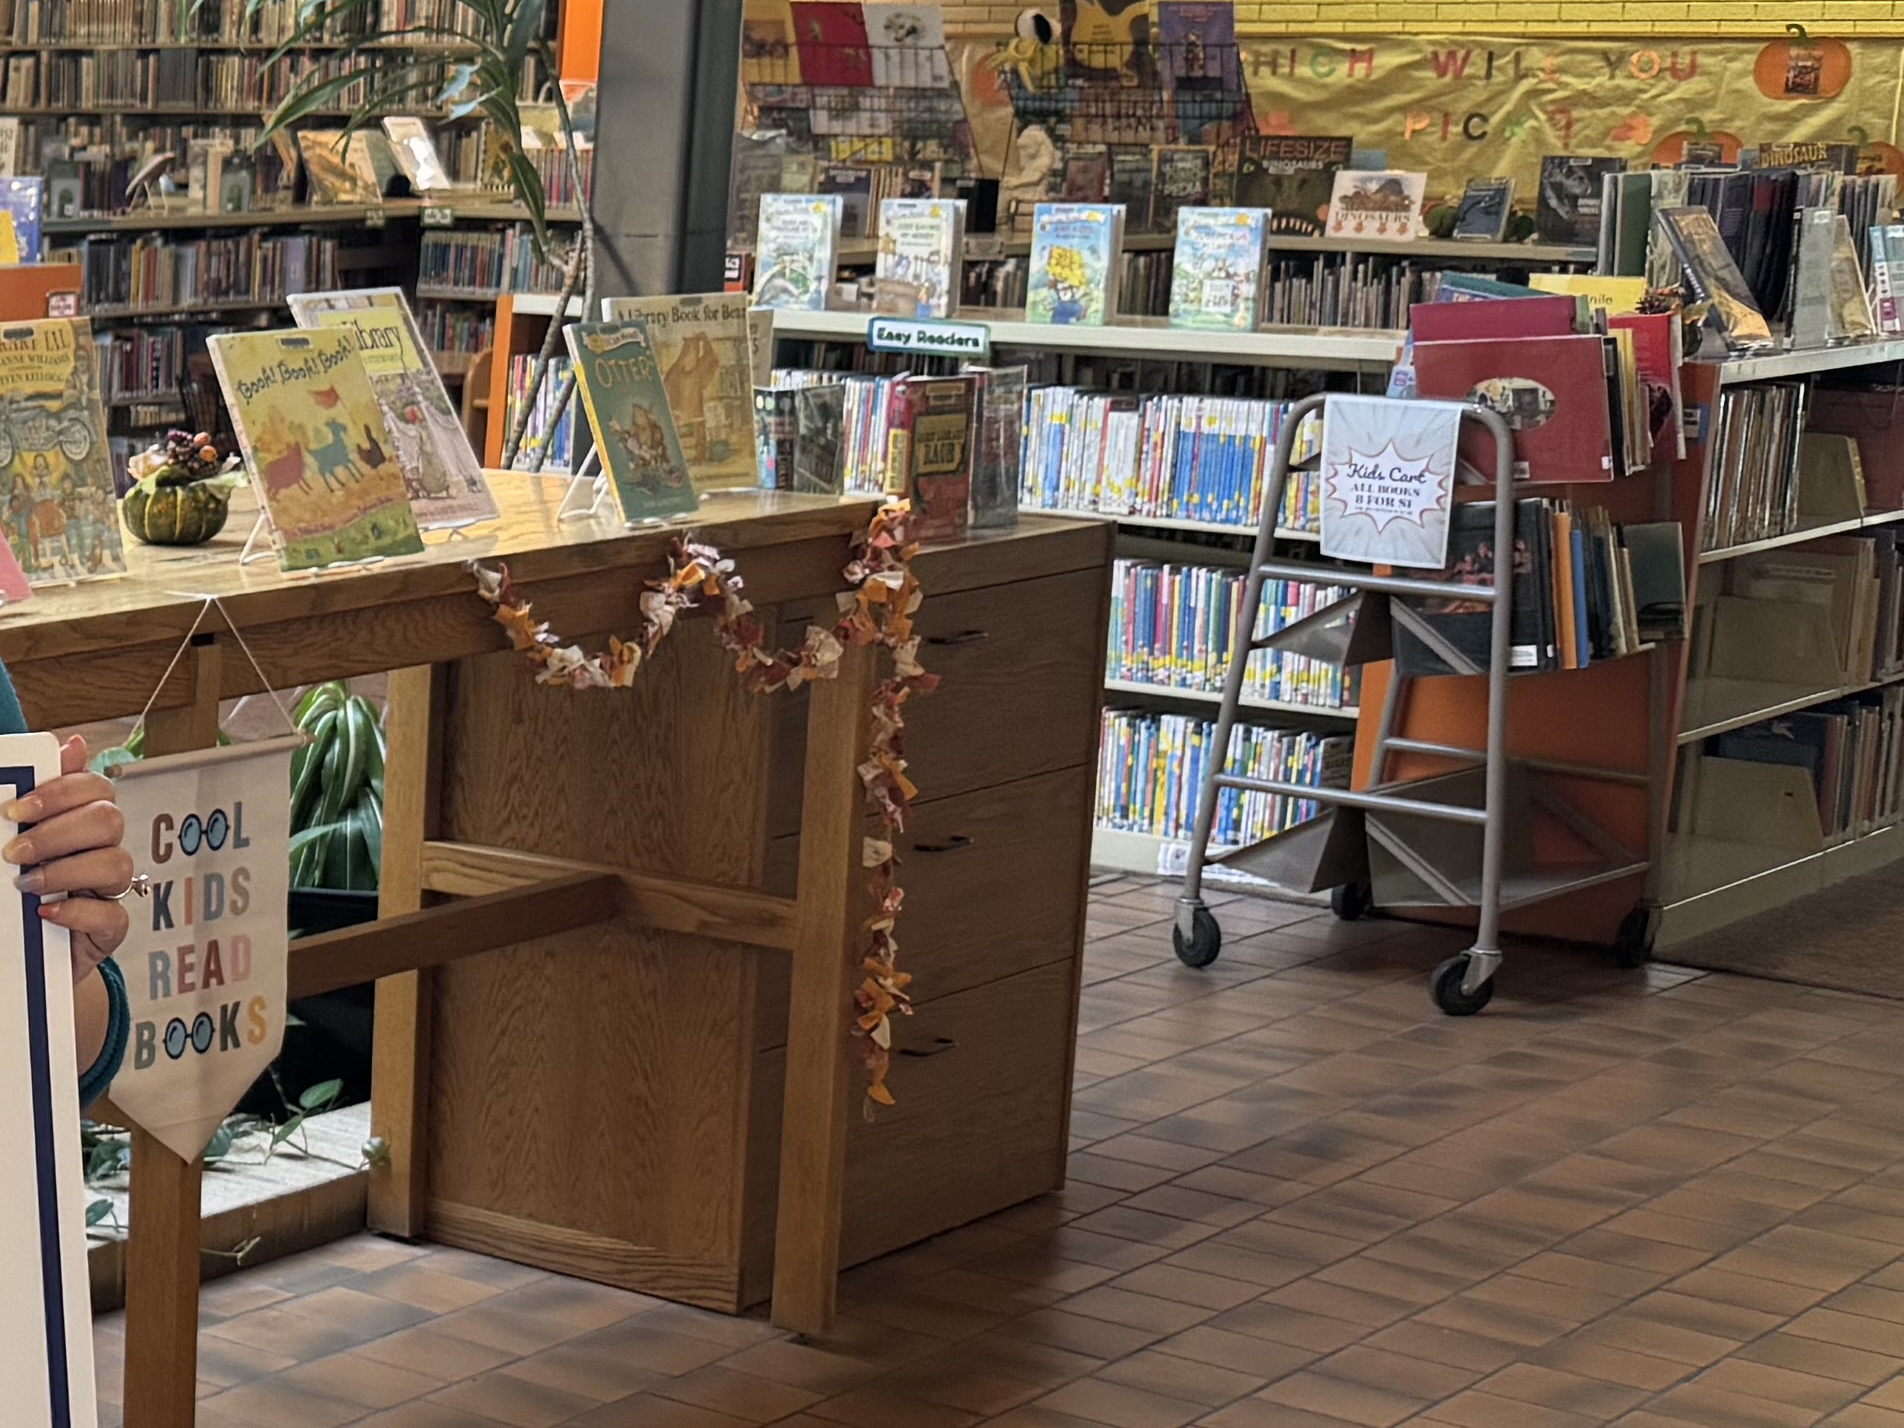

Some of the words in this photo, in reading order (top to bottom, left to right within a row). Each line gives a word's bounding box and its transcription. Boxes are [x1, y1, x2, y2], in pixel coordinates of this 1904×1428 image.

[1600, 48, 1700, 83] YOU
[1245, 139, 1348, 160] LIFESIZE
[1759, 143, 1829, 170] DINOSAUR
[671, 304, 701, 323] Book
[703, 304, 719, 321] for
[876, 327, 913, 346] Easy
[916, 329, 981, 349] Readers
[1346, 462, 1388, 480] Kids
[1389, 466, 1428, 485] Cart
[149, 800, 252, 865] COOL
[151, 865, 252, 933] KIDS
[148, 933, 253, 1002] READ
[133, 994, 269, 1071] BOOKS
